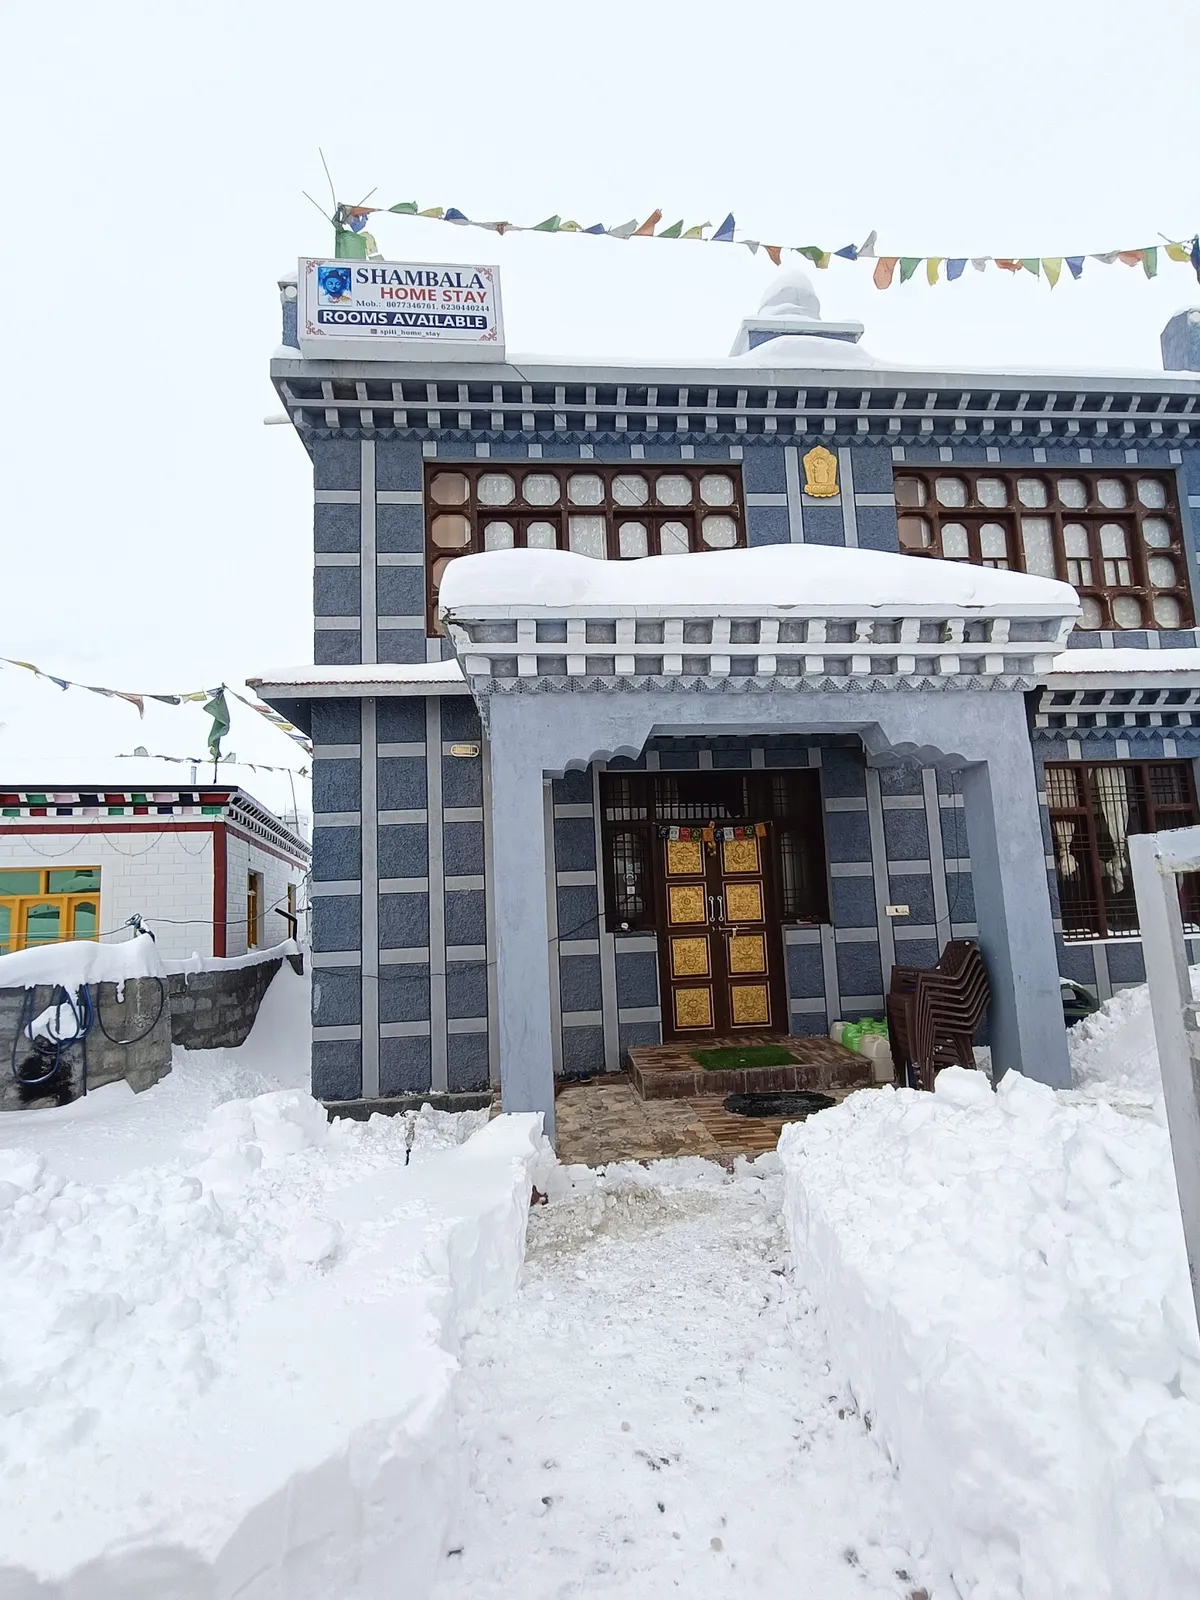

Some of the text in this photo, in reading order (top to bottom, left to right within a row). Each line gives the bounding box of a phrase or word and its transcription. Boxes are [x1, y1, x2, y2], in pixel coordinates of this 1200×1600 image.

[356, 268, 485, 289] SHAMBALA
[381, 287, 487, 303] HOME STAY
[323, 311, 484, 328] ROOMS AVAILABLE
